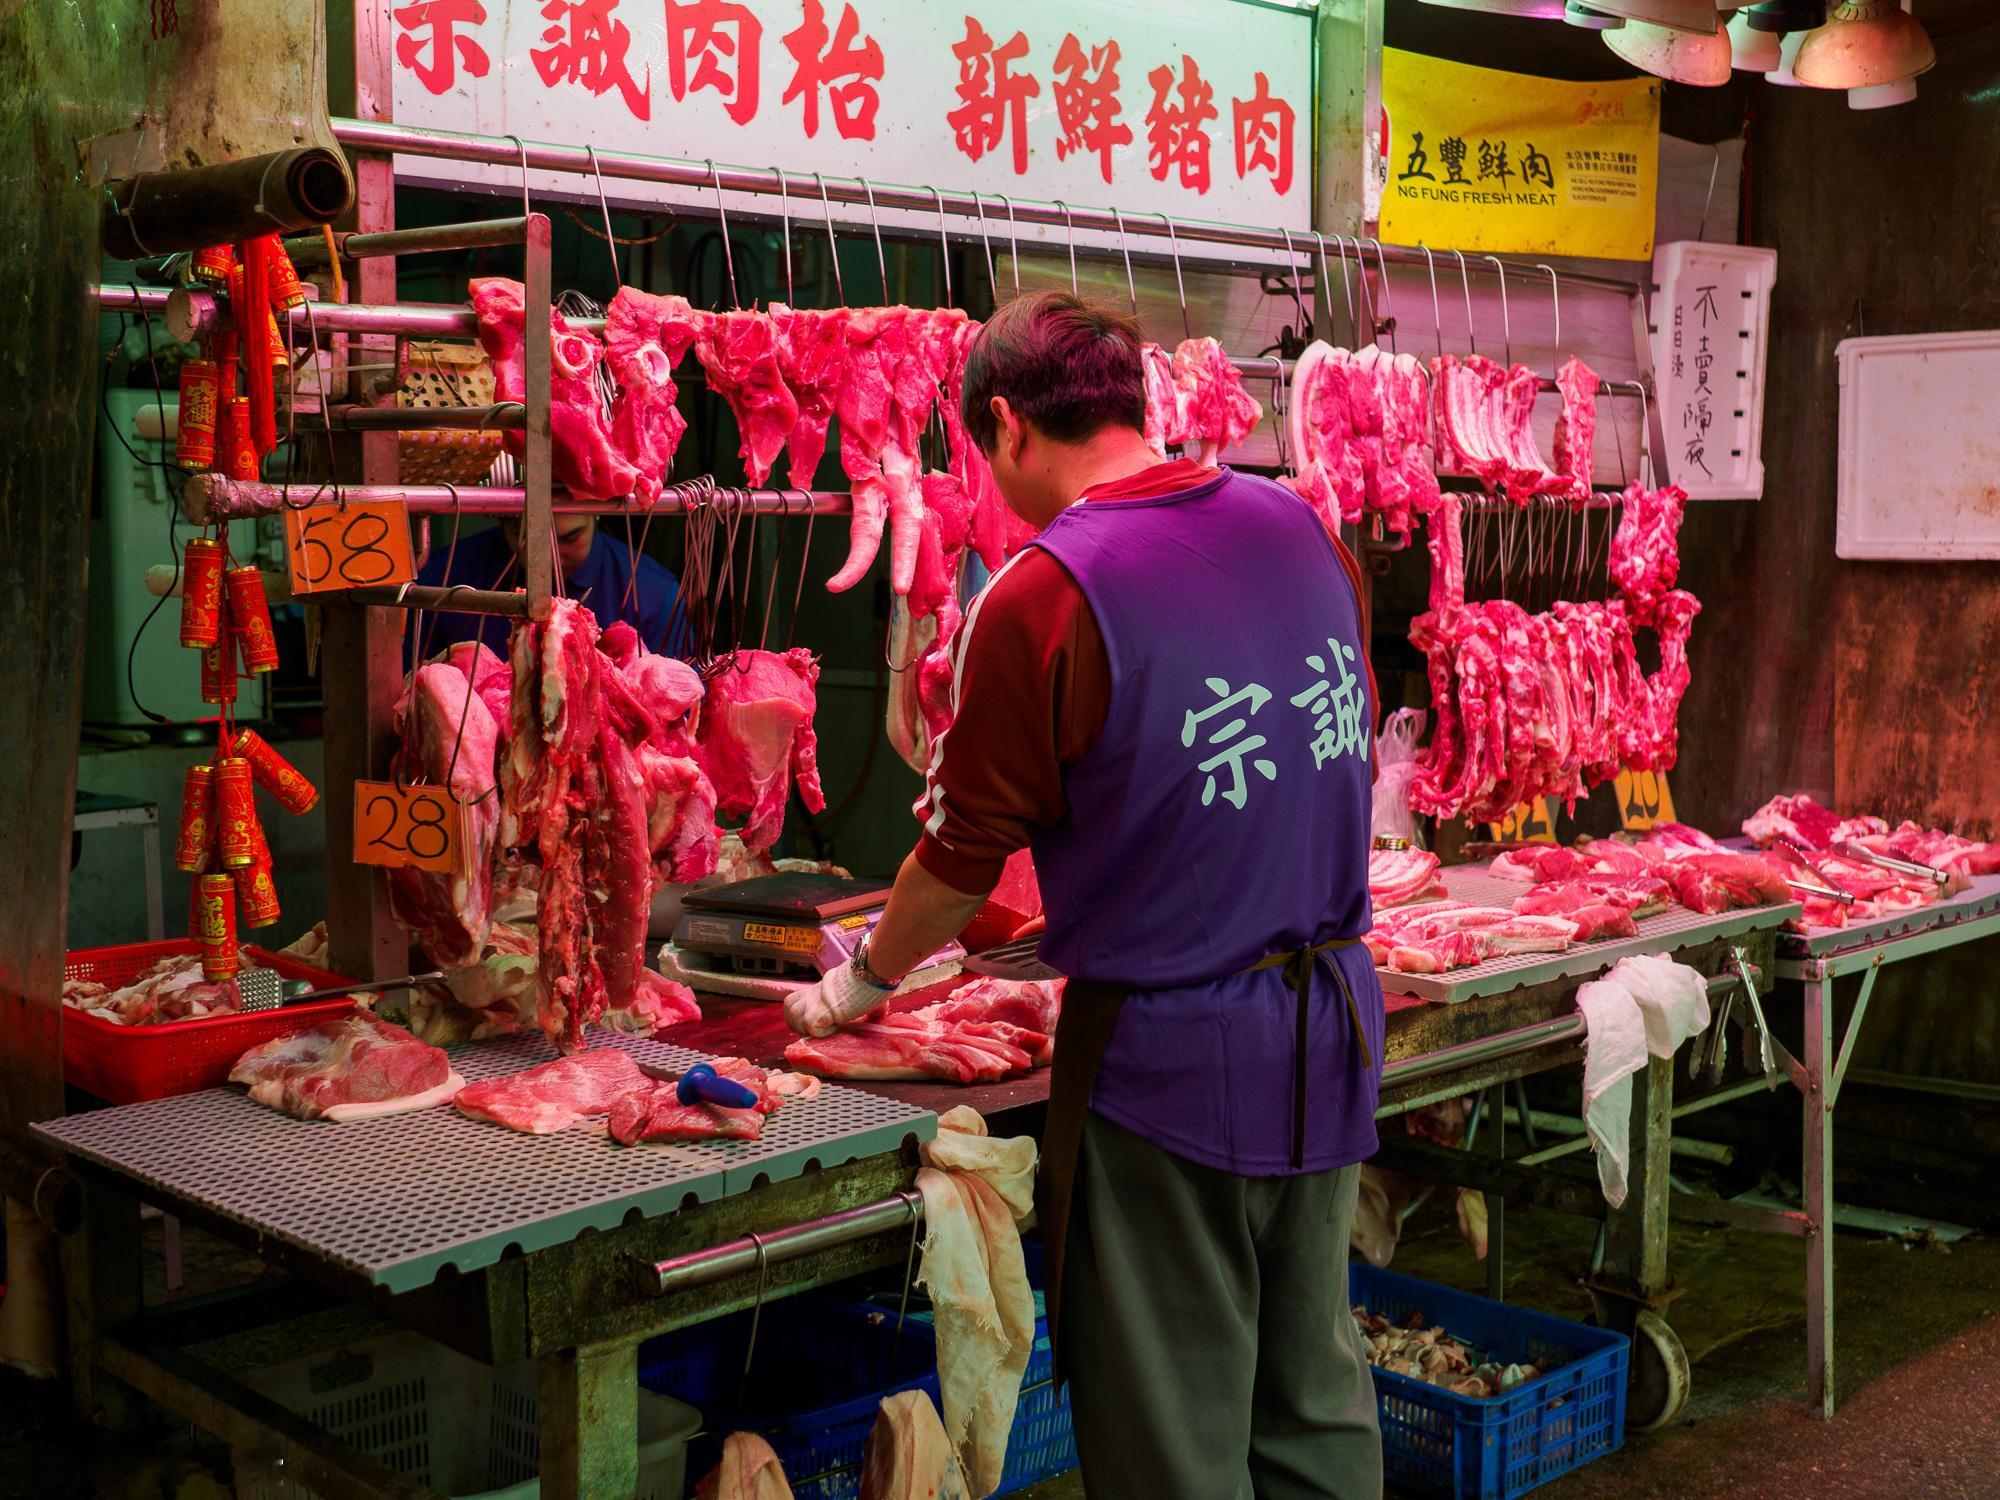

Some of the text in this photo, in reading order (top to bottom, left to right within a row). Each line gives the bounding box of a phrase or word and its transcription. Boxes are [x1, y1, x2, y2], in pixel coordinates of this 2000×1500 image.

[947, 15, 1296, 196] 新鮮豬肉
[1398, 131, 1555, 189] 五豐鮮肉
[1398, 185, 1418, 198] NG
[1421, 187, 1460, 202] FUNG
[1463, 191, 1513, 205] FRESH
[1516, 193, 1557, 207] MEAT
[295, 512, 395, 584] 58
[1181, 637, 1370, 810] 宗誠
[366, 794, 449, 858] 28
